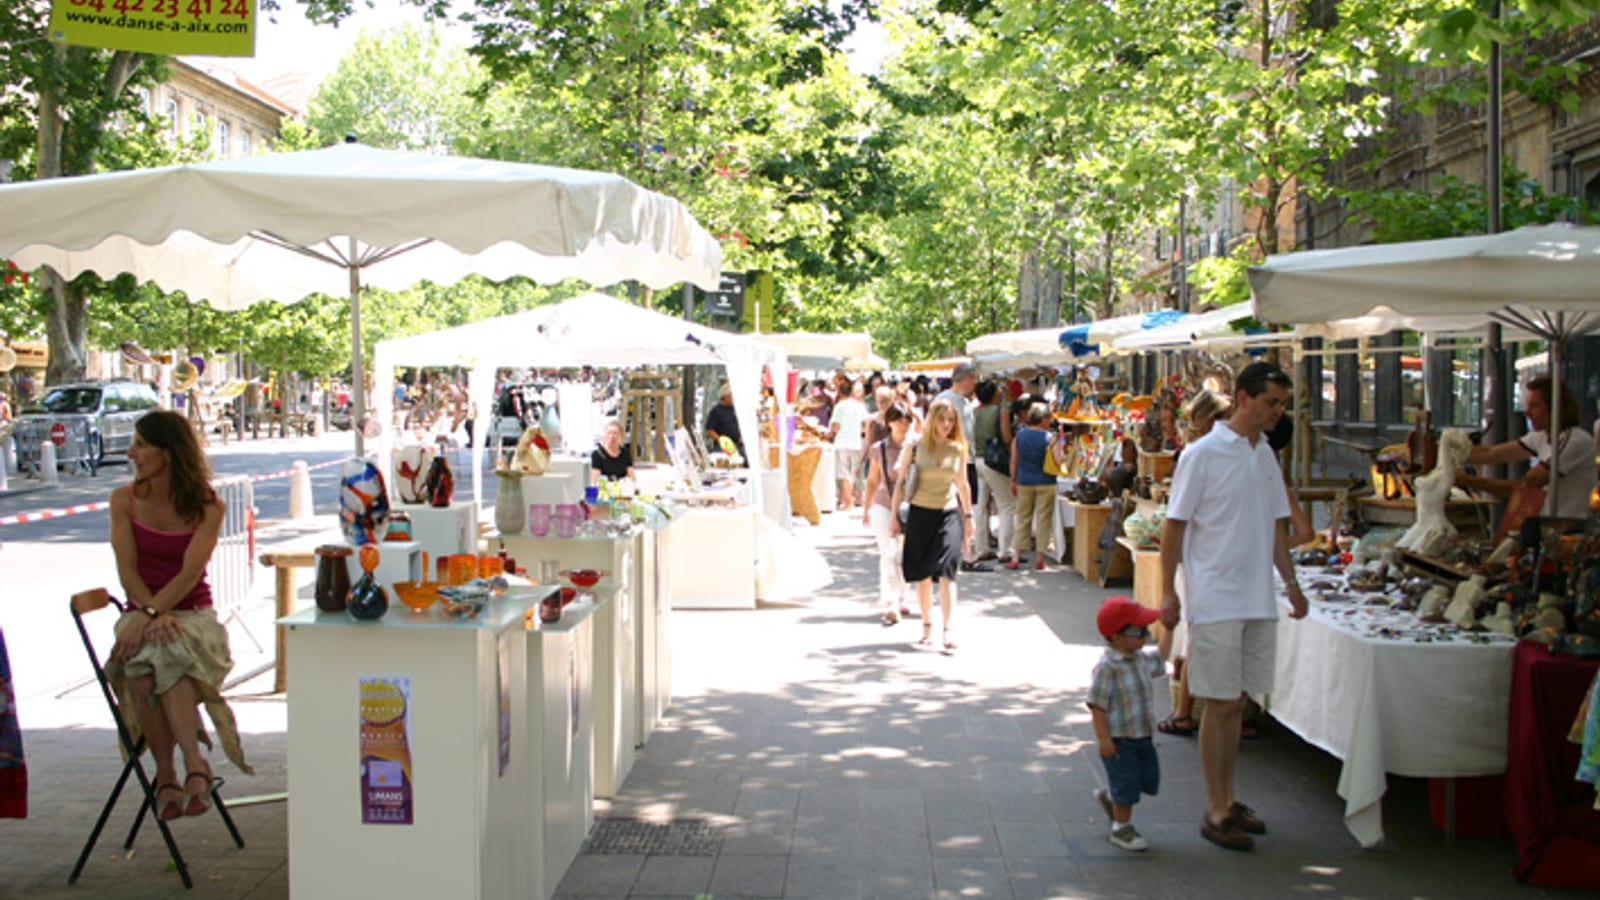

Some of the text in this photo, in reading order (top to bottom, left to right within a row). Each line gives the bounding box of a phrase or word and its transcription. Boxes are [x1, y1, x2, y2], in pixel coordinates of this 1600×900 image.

[113, 0, 143, 15] 42
[152, 0, 178, 18] 23
[187, 0, 212, 18] 41
[220, 0, 249, 19] 24
[66, 12, 248, 33] www.danse-a-aix.com
